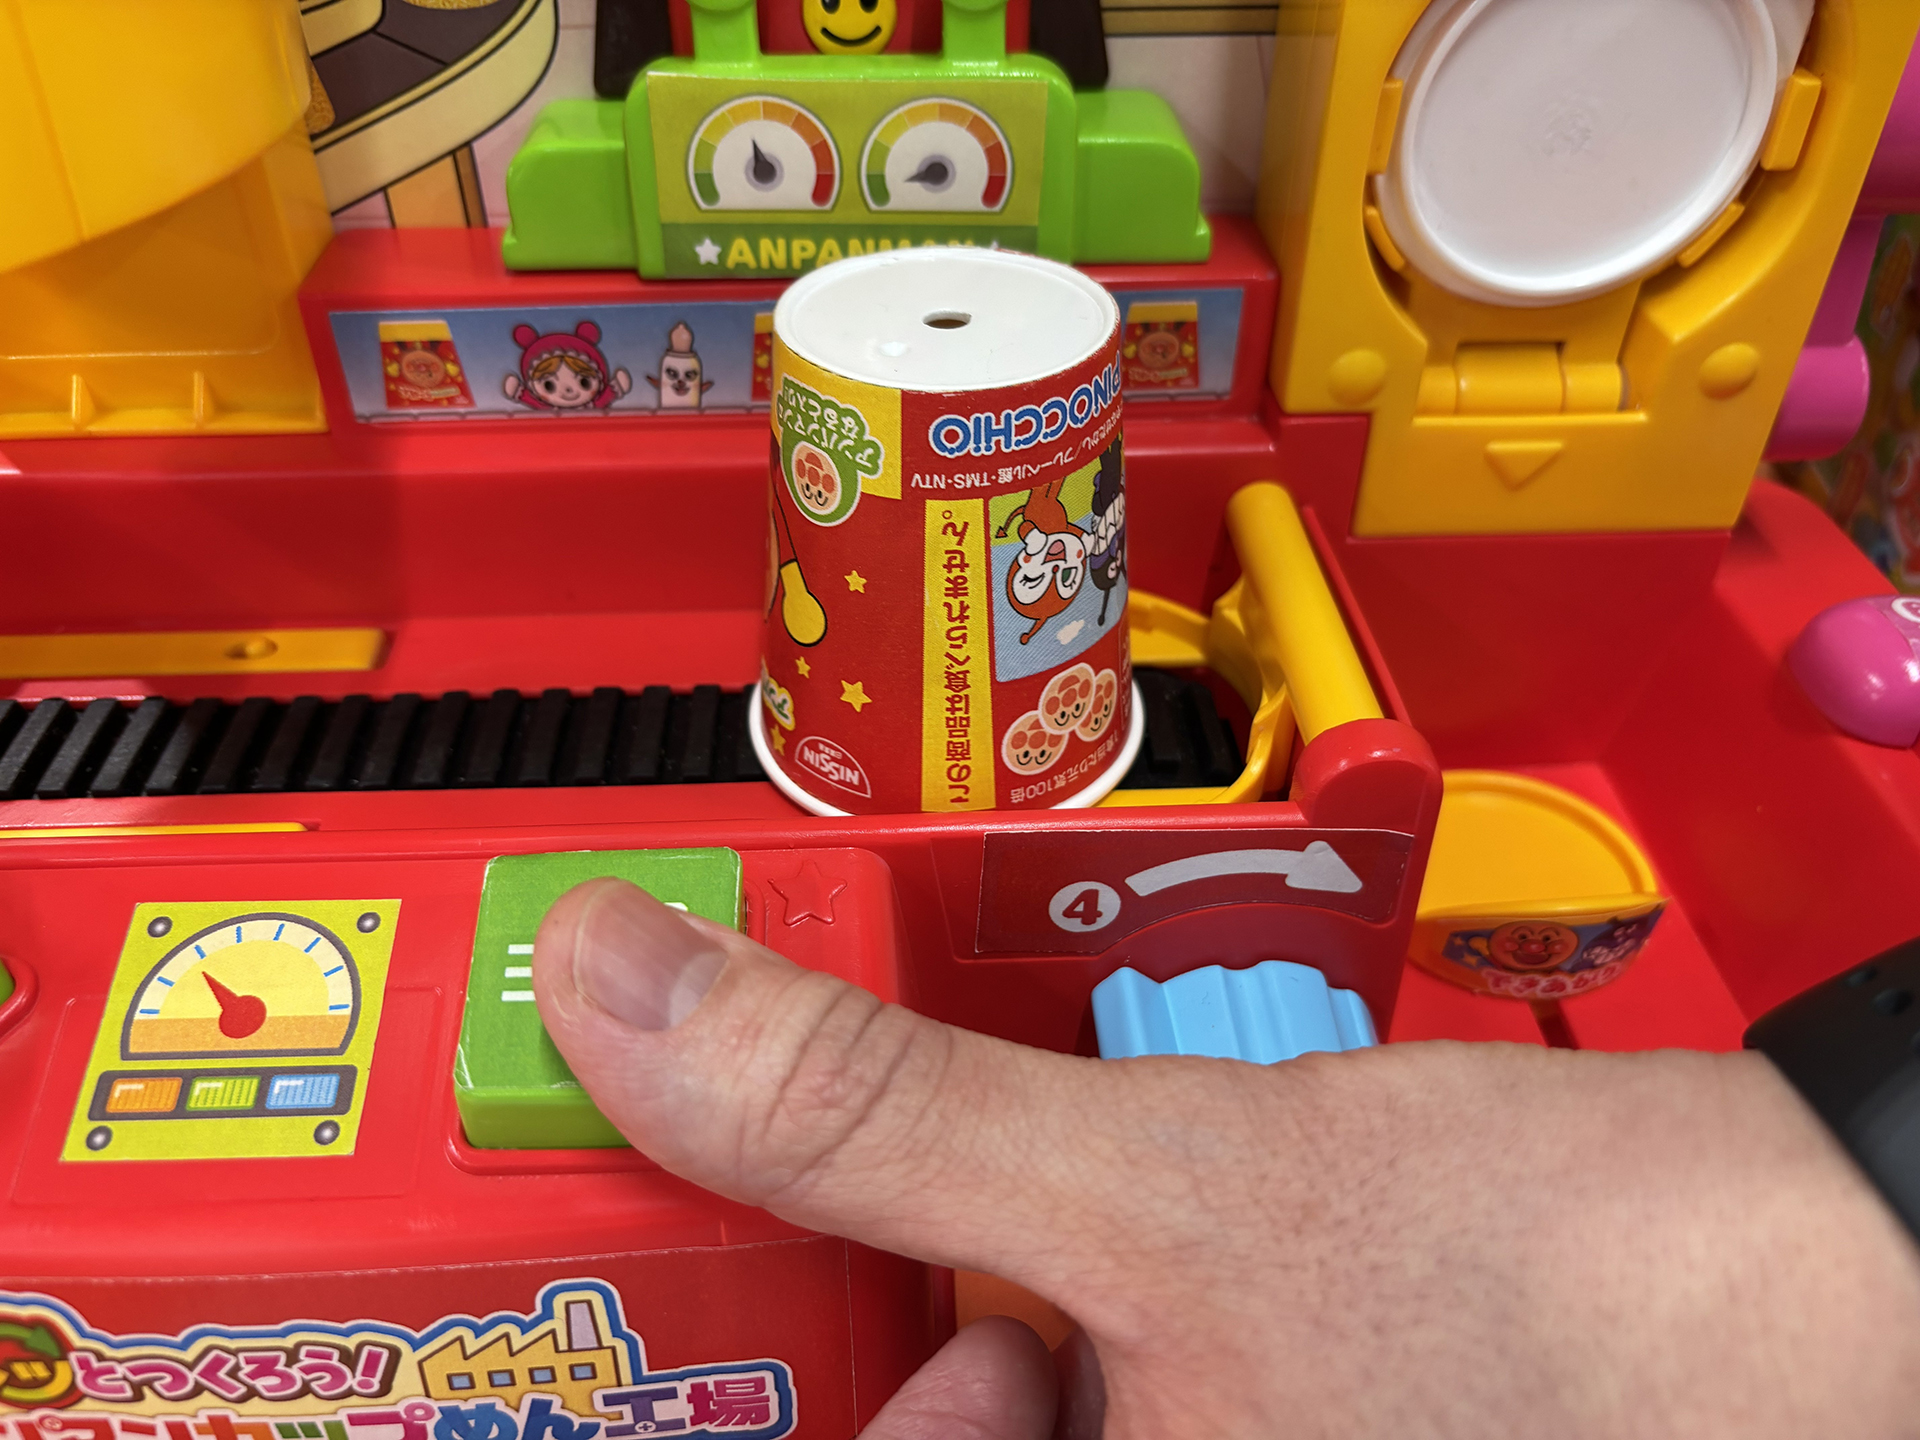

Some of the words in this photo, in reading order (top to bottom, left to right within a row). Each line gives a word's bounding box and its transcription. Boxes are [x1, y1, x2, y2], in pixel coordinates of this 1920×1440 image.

[941, 509, 972, 804] この商品は食べられません。
[803, 745, 860, 786] NISSIN
[1062, 888, 1104, 926] 4
